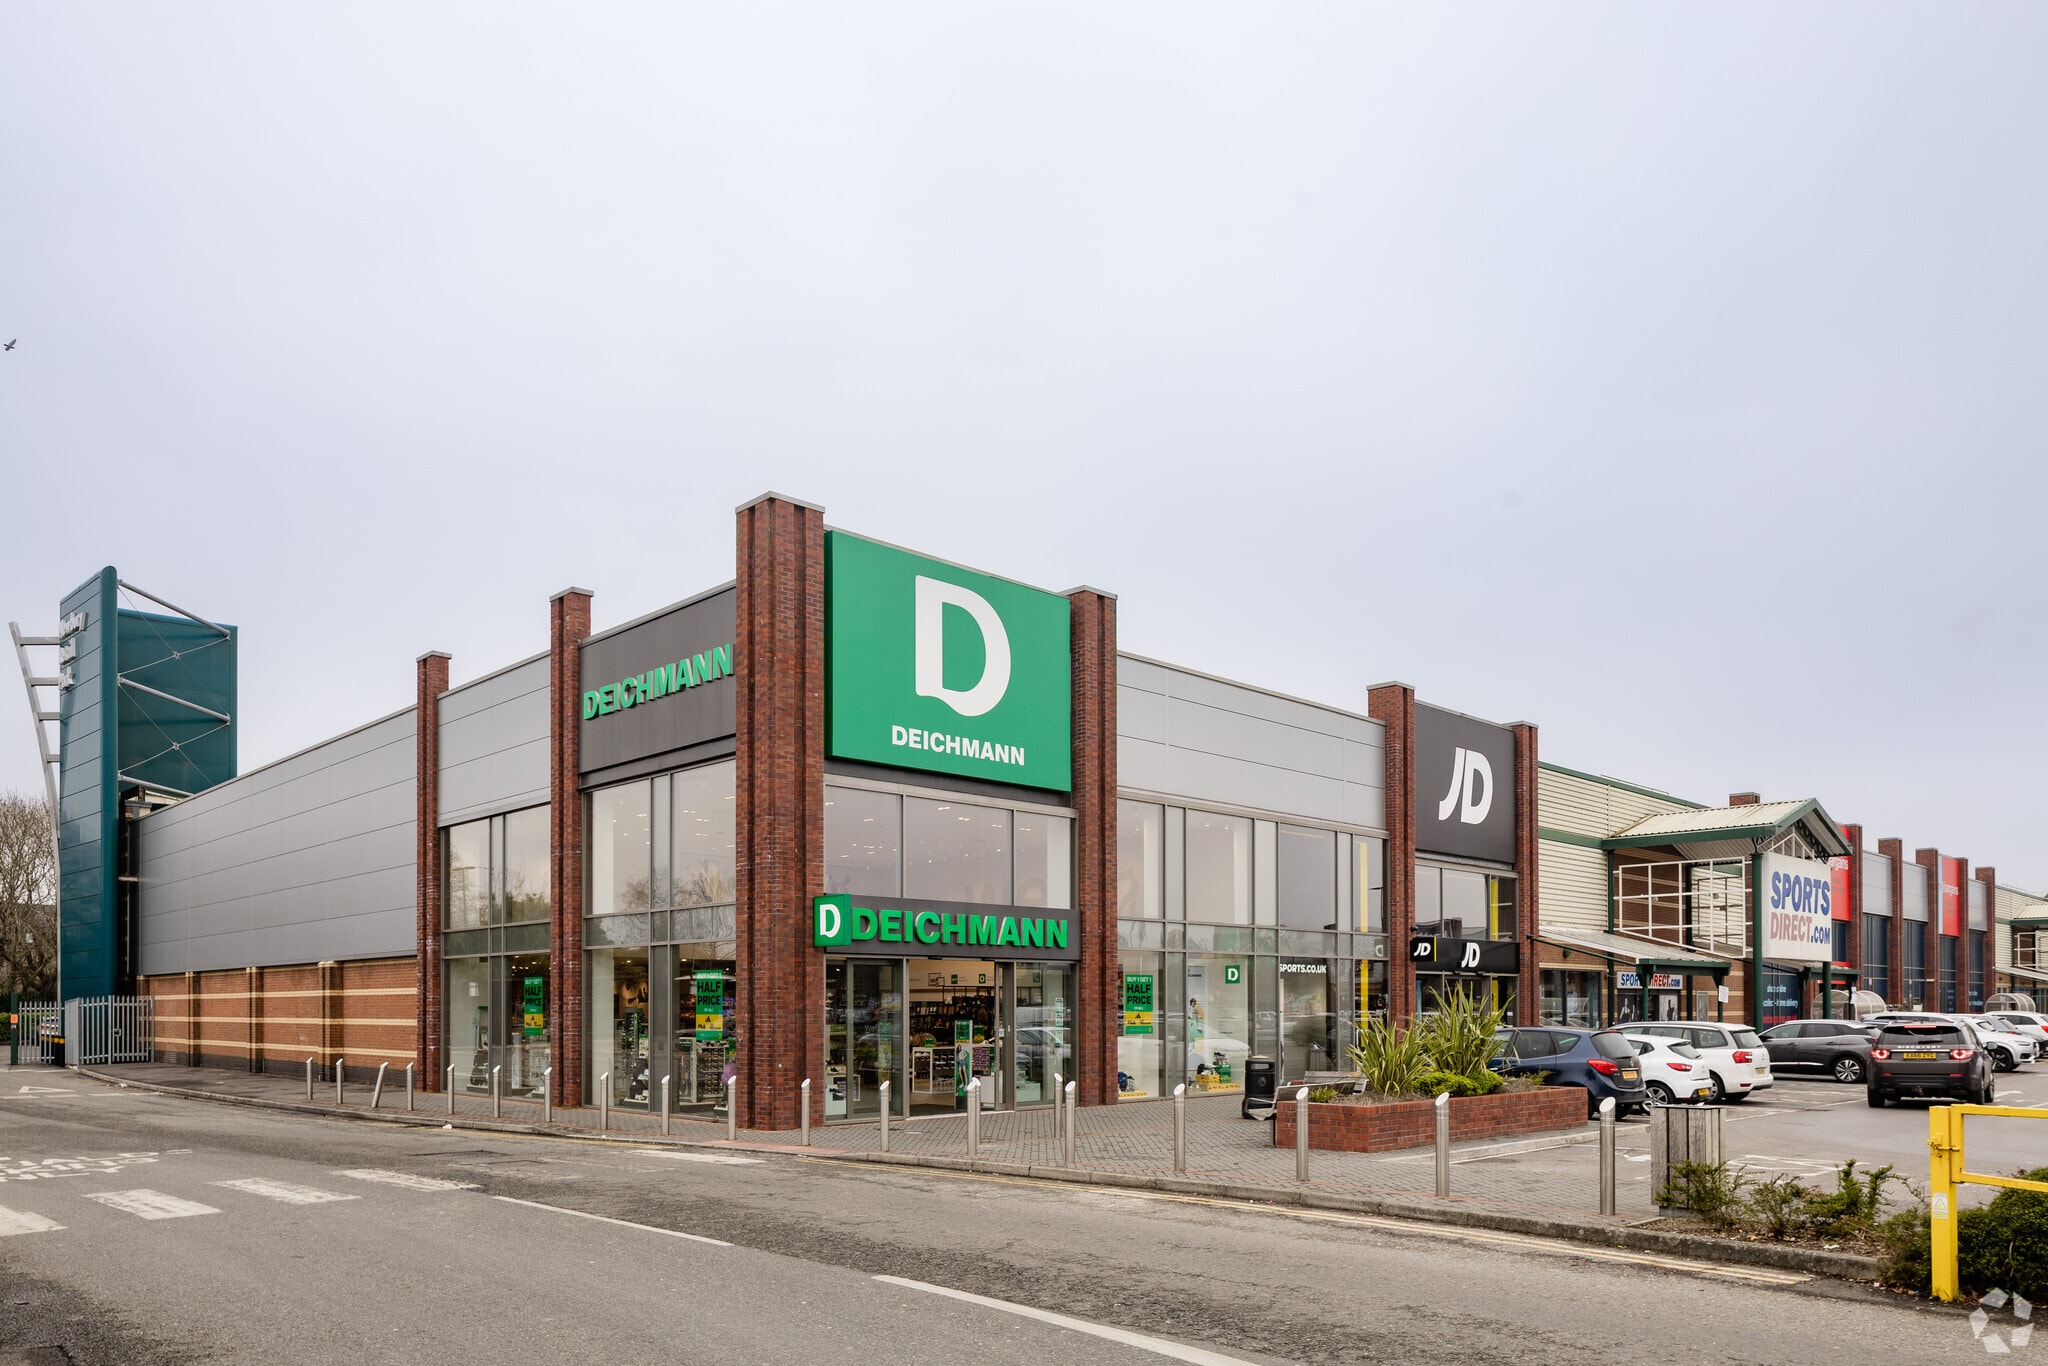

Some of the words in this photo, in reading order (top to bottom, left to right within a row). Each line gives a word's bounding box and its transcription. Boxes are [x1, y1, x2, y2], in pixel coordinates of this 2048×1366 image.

[914, 574, 1012, 717] D
[582, 643, 735, 720] DEICHMANN
[891, 724, 1025, 766] DEICHMANN
[1438, 746, 1494, 825] JD
[1770, 870, 1830, 916] SPORTS
[851, 907, 1068, 949] DEICHMANN
[1770, 911, 1831, 945] DIRECT.COM
[1413, 942, 1432, 957] JD
[1461, 942, 1481, 968] JD
[1227, 968, 1239, 981] D
[1620, 973, 1641, 987] SPOR
[525, 986, 542, 996] HALF
[697, 981, 722, 993] HALF
[1127, 983, 1152, 994] HALF
[525, 997, 542, 1007] PRICE
[697, 995, 722, 1006] PRICE
[1127, 995, 1152, 1005] PRICE
